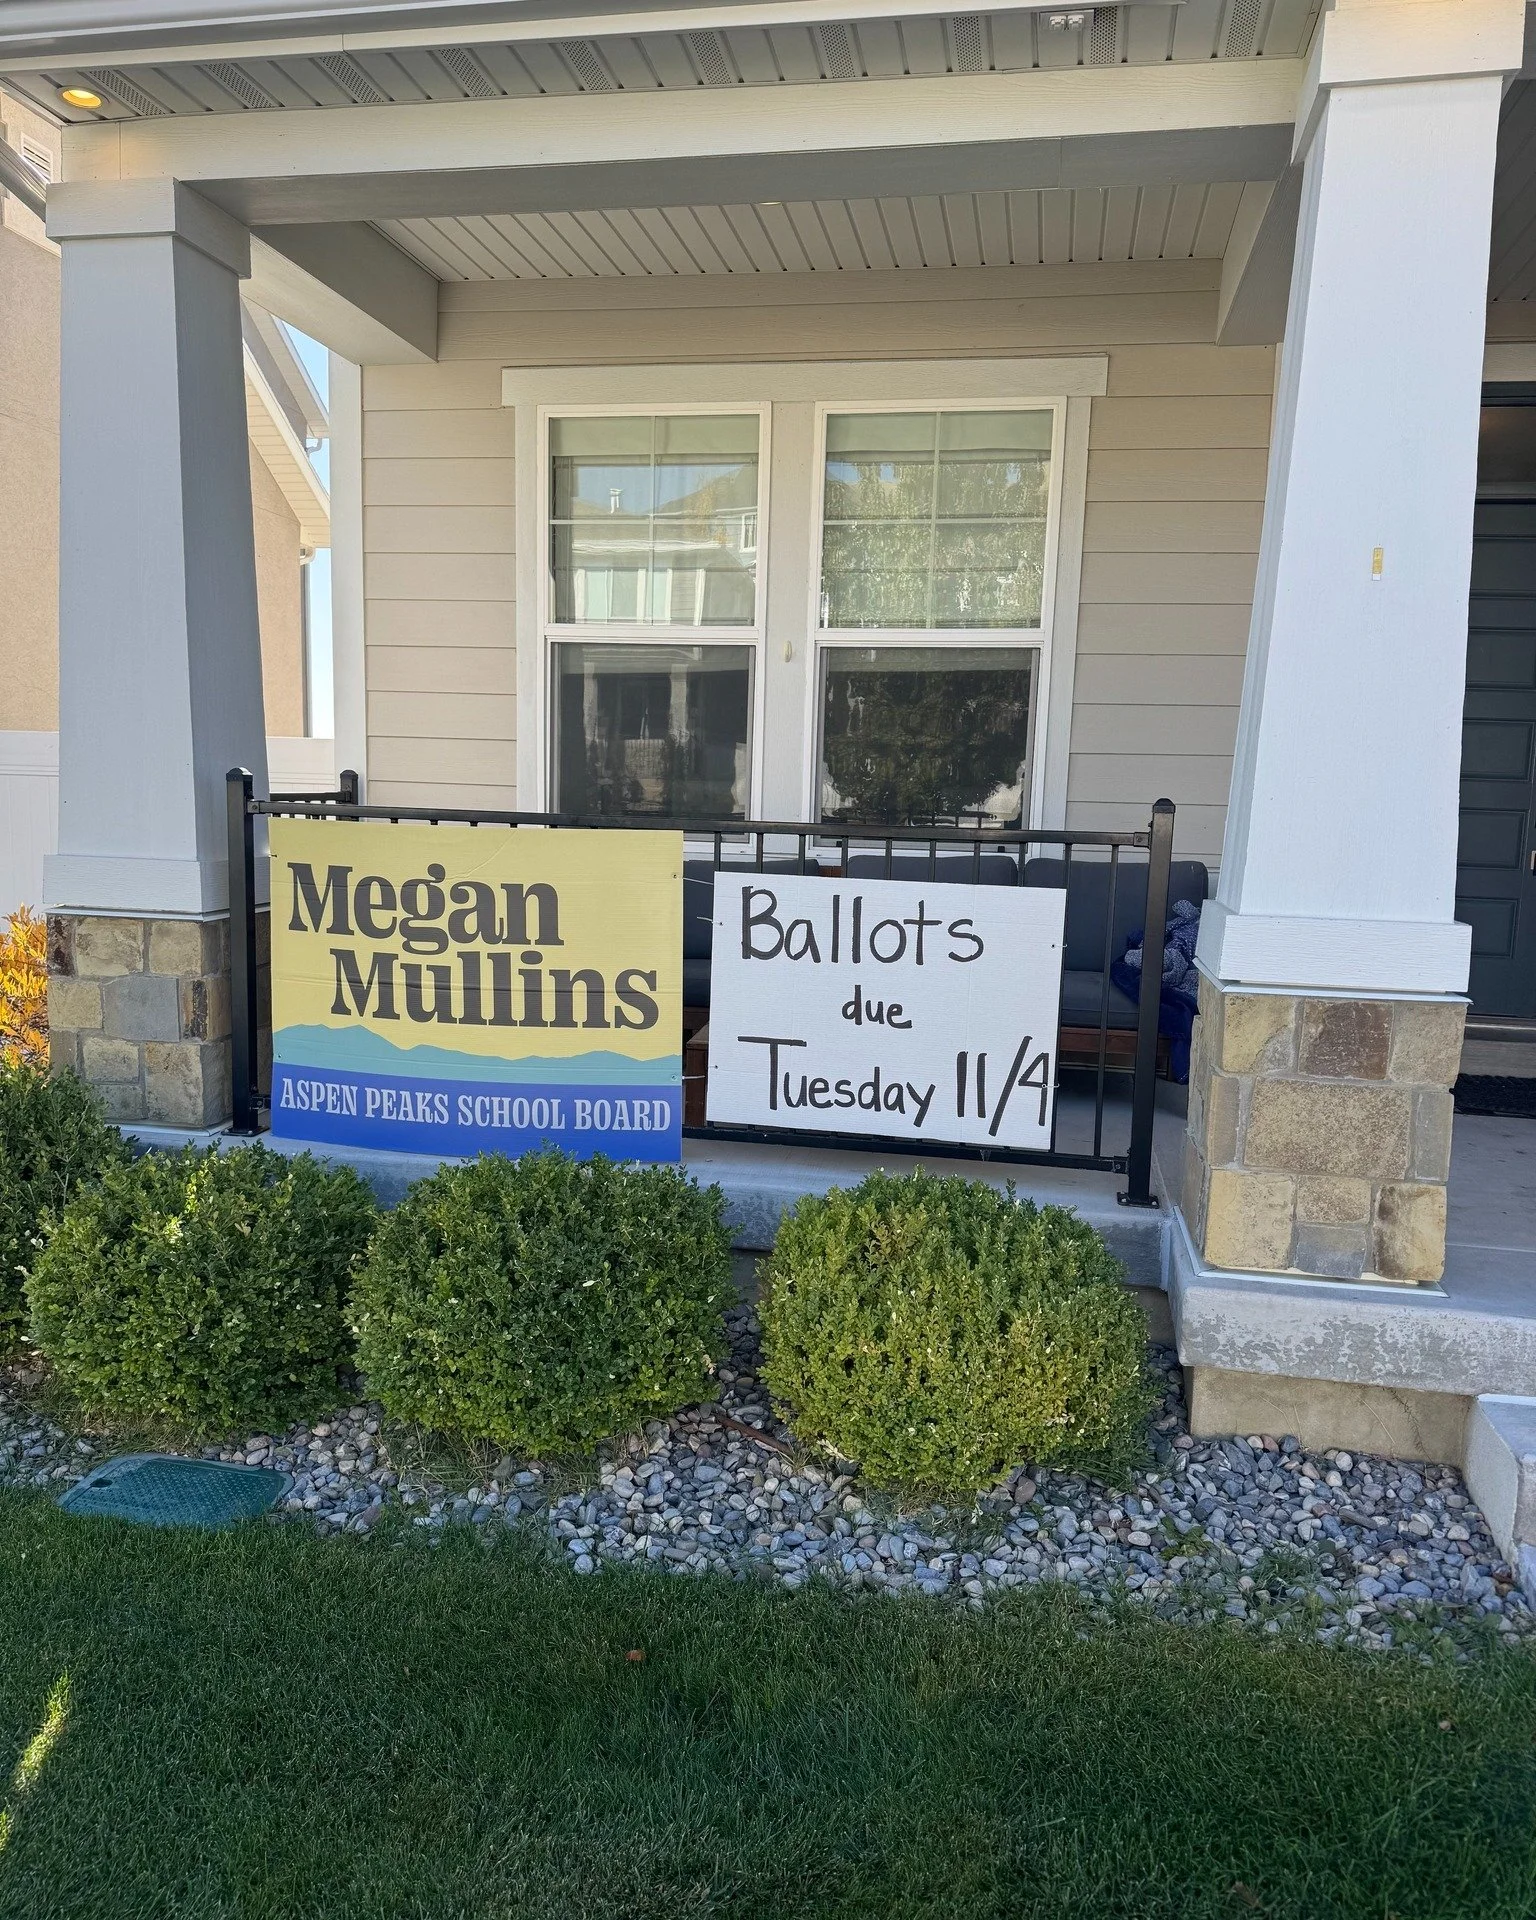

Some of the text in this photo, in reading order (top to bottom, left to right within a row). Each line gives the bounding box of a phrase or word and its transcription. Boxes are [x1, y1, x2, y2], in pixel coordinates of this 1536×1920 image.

[287, 862, 565, 955] Megan
[741, 886, 985, 966] Ballots
[329, 948, 660, 1030] Mullins
[841, 984, 913, 1029] due
[280, 1077, 671, 1132] ASPEN PEAKS SCHOOL BOARD
[737, 1035, 1050, 1137] Tuesday 11/4
